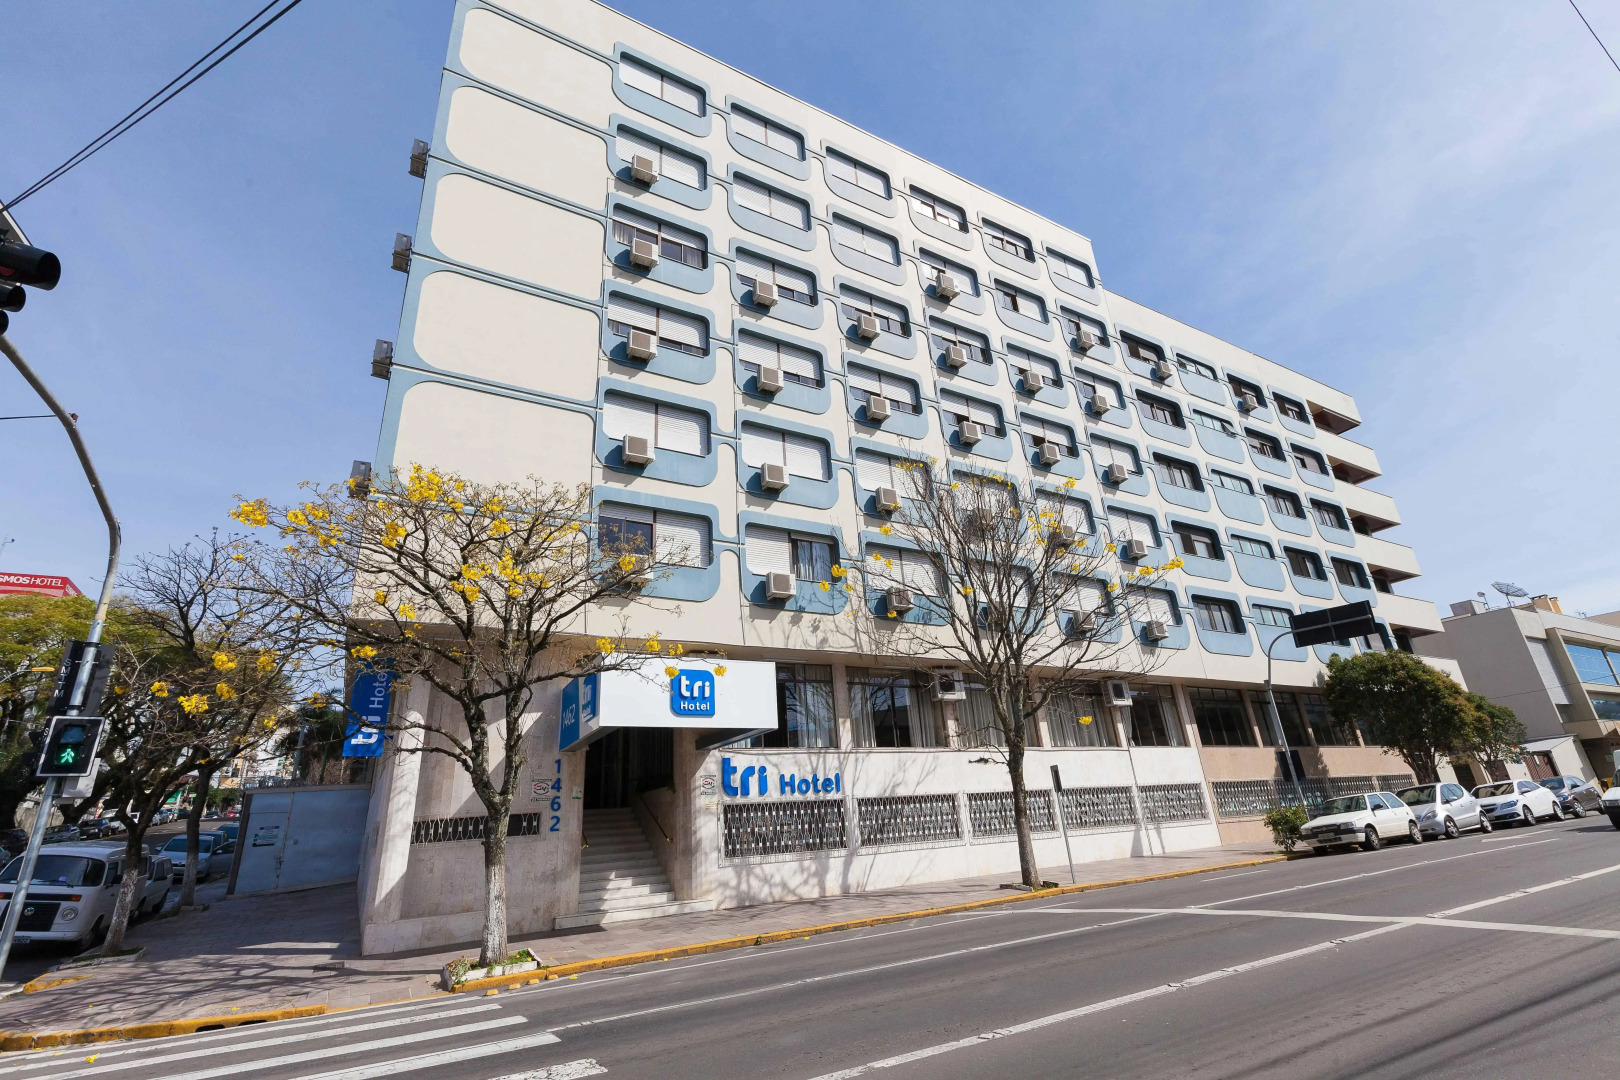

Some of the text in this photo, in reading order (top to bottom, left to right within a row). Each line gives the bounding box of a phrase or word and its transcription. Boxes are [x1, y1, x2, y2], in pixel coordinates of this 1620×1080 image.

[30, 577, 64, 587] HOTEL
[680, 675, 710, 698] tri
[562, 703, 576, 730] 1462
[680, 701, 710, 711] Hotel
[351, 716, 381, 745] tri
[721, 757, 768, 797] tri
[780, 772, 842, 795] Hotel
[549, 758, 563, 832] 1462
